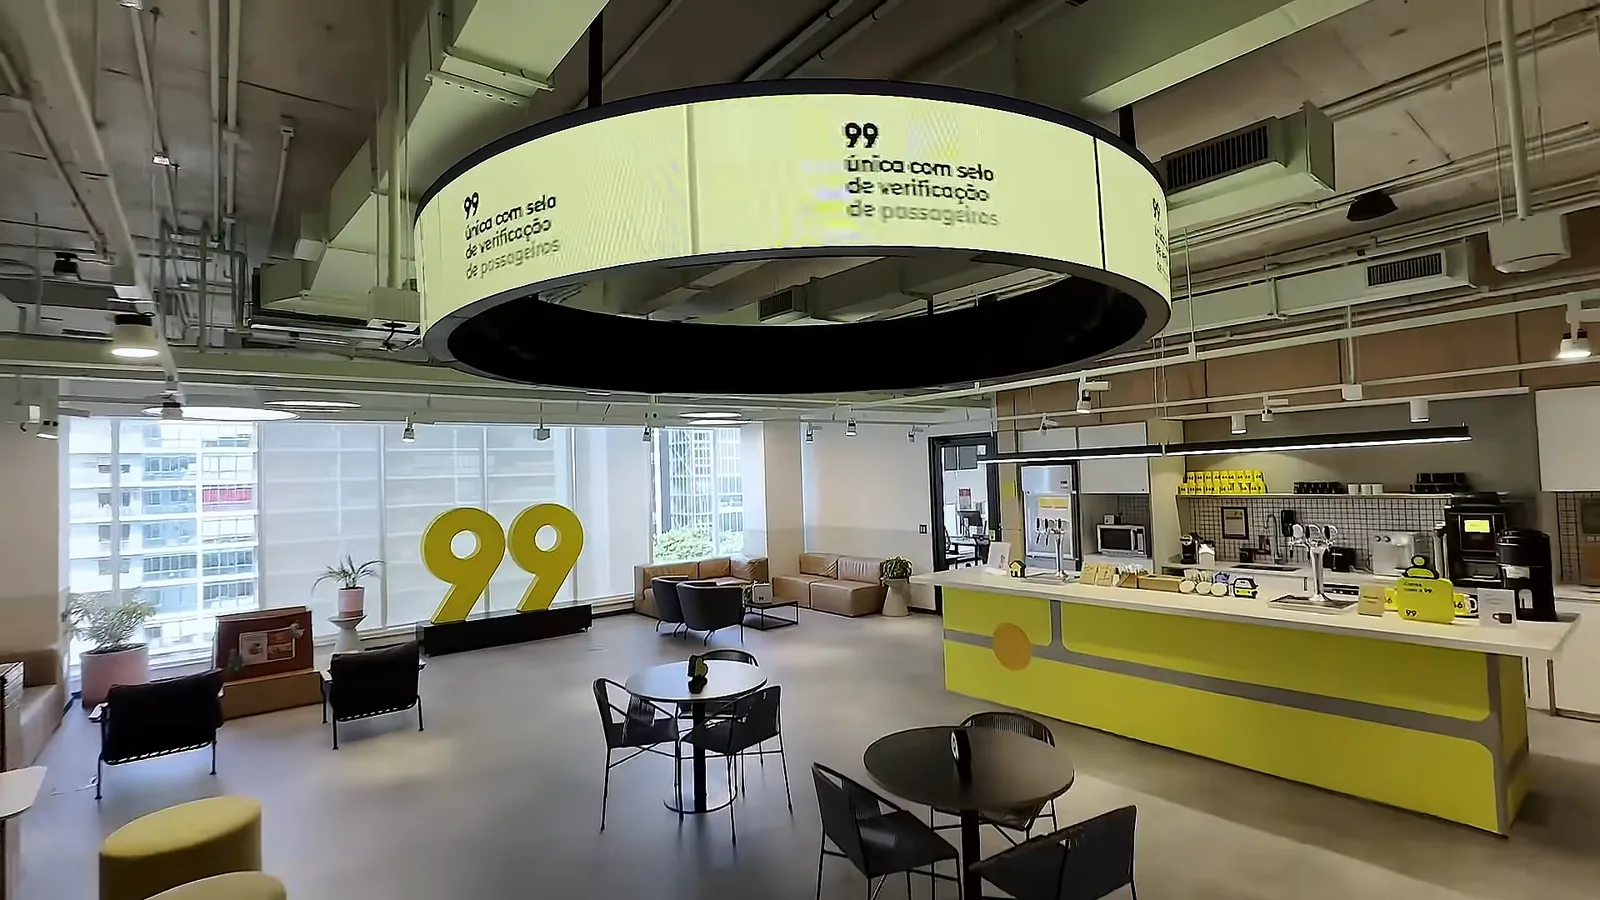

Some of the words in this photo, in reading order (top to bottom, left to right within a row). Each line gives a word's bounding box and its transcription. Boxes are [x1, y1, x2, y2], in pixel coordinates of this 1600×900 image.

[845, 122, 879, 148] 99
[845, 154, 905, 173] única
[909, 161, 951, 177] com
[956, 163, 995, 182] selo
[847, 177, 873, 194] de
[878, 178, 990, 204] verificação
[463, 191, 479, 220] 99
[465, 217, 493, 241] única
[495, 206, 523, 226] com
[526, 194, 556, 216] selo
[848, 200, 876, 217] de
[880, 203, 1000, 227] passageiros
[465, 243, 478, 260] de
[478, 217, 552, 254] verificação
[466, 261, 479, 280] de
[480, 239, 559, 279] passageiros
[420, 502, 585, 624] 99
